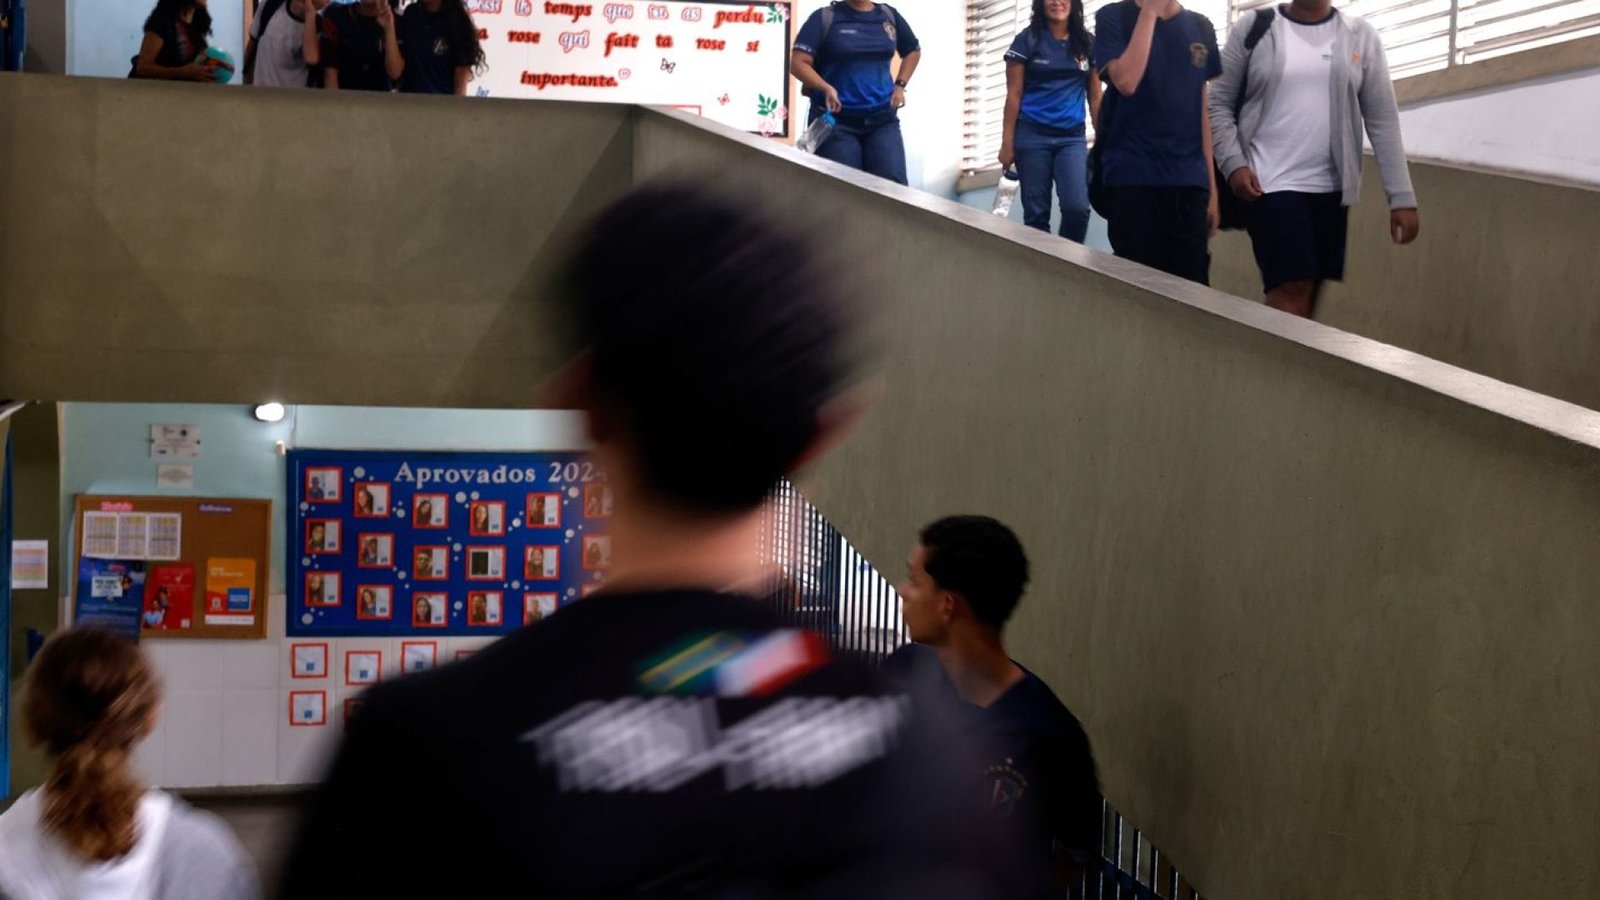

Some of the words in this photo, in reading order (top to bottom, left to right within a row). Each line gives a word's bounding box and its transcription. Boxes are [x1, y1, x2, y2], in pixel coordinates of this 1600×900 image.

[544, 1, 592, 22] temps
[604, 3, 633, 23] que
[648, 5, 668, 19] tu
[681, 7, 701, 21] as
[713, 5, 764, 28] perdu
[508, 30, 540, 43] rose
[559, 31, 589, 53] qui
[604, 33, 639, 57] fait
[655, 34, 673, 48] ta
[696, 37, 725, 51] rose
[746, 40, 759, 52] si
[394, 461, 536, 489] Aprovados
